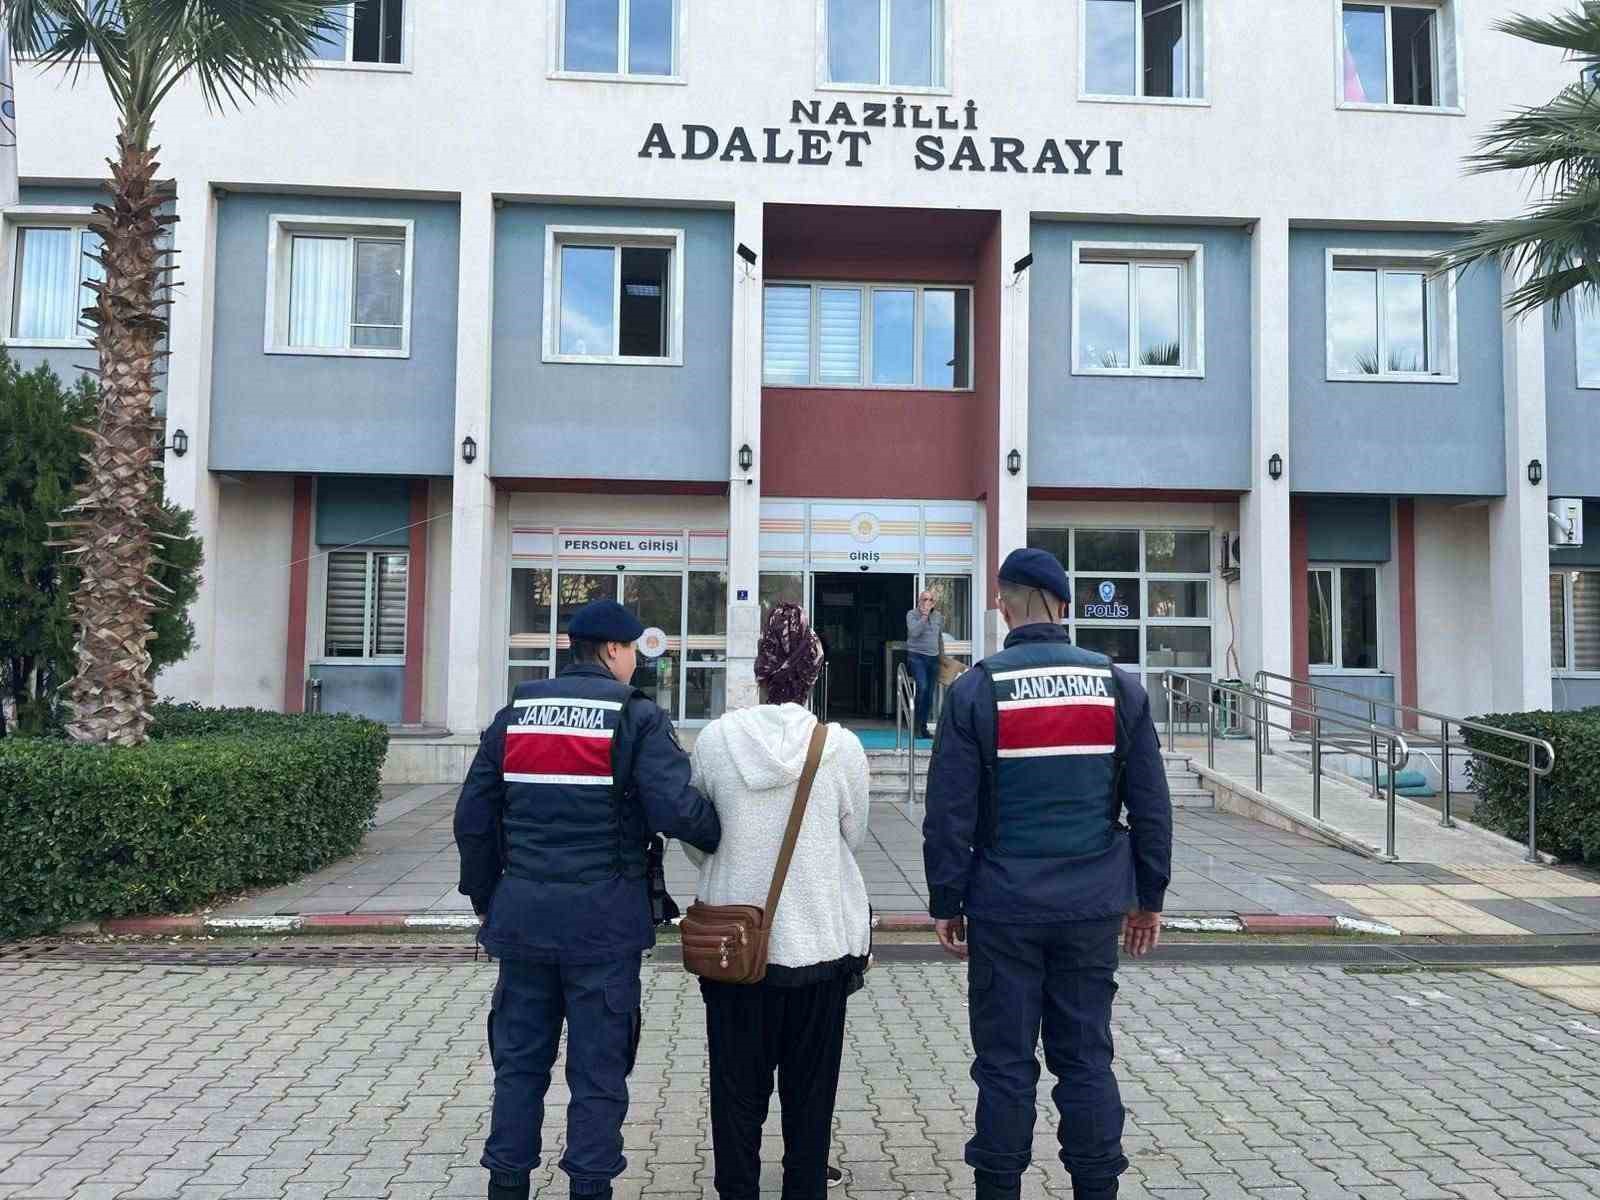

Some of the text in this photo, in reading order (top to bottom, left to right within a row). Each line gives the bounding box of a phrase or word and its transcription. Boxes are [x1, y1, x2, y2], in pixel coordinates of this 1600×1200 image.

[790, 96, 978, 130] NAZİLLİ
[638, 123, 1123, 176] ADALET SARAYI
[564, 539, 679, 554] PERSONEL GİRİŞİ
[849, 550, 881, 563] GİRİŞ
[1084, 602, 1129, 618] POLİS
[1010, 675, 1108, 700] JANDARMA
[518, 705, 605, 729] JANDARMA
